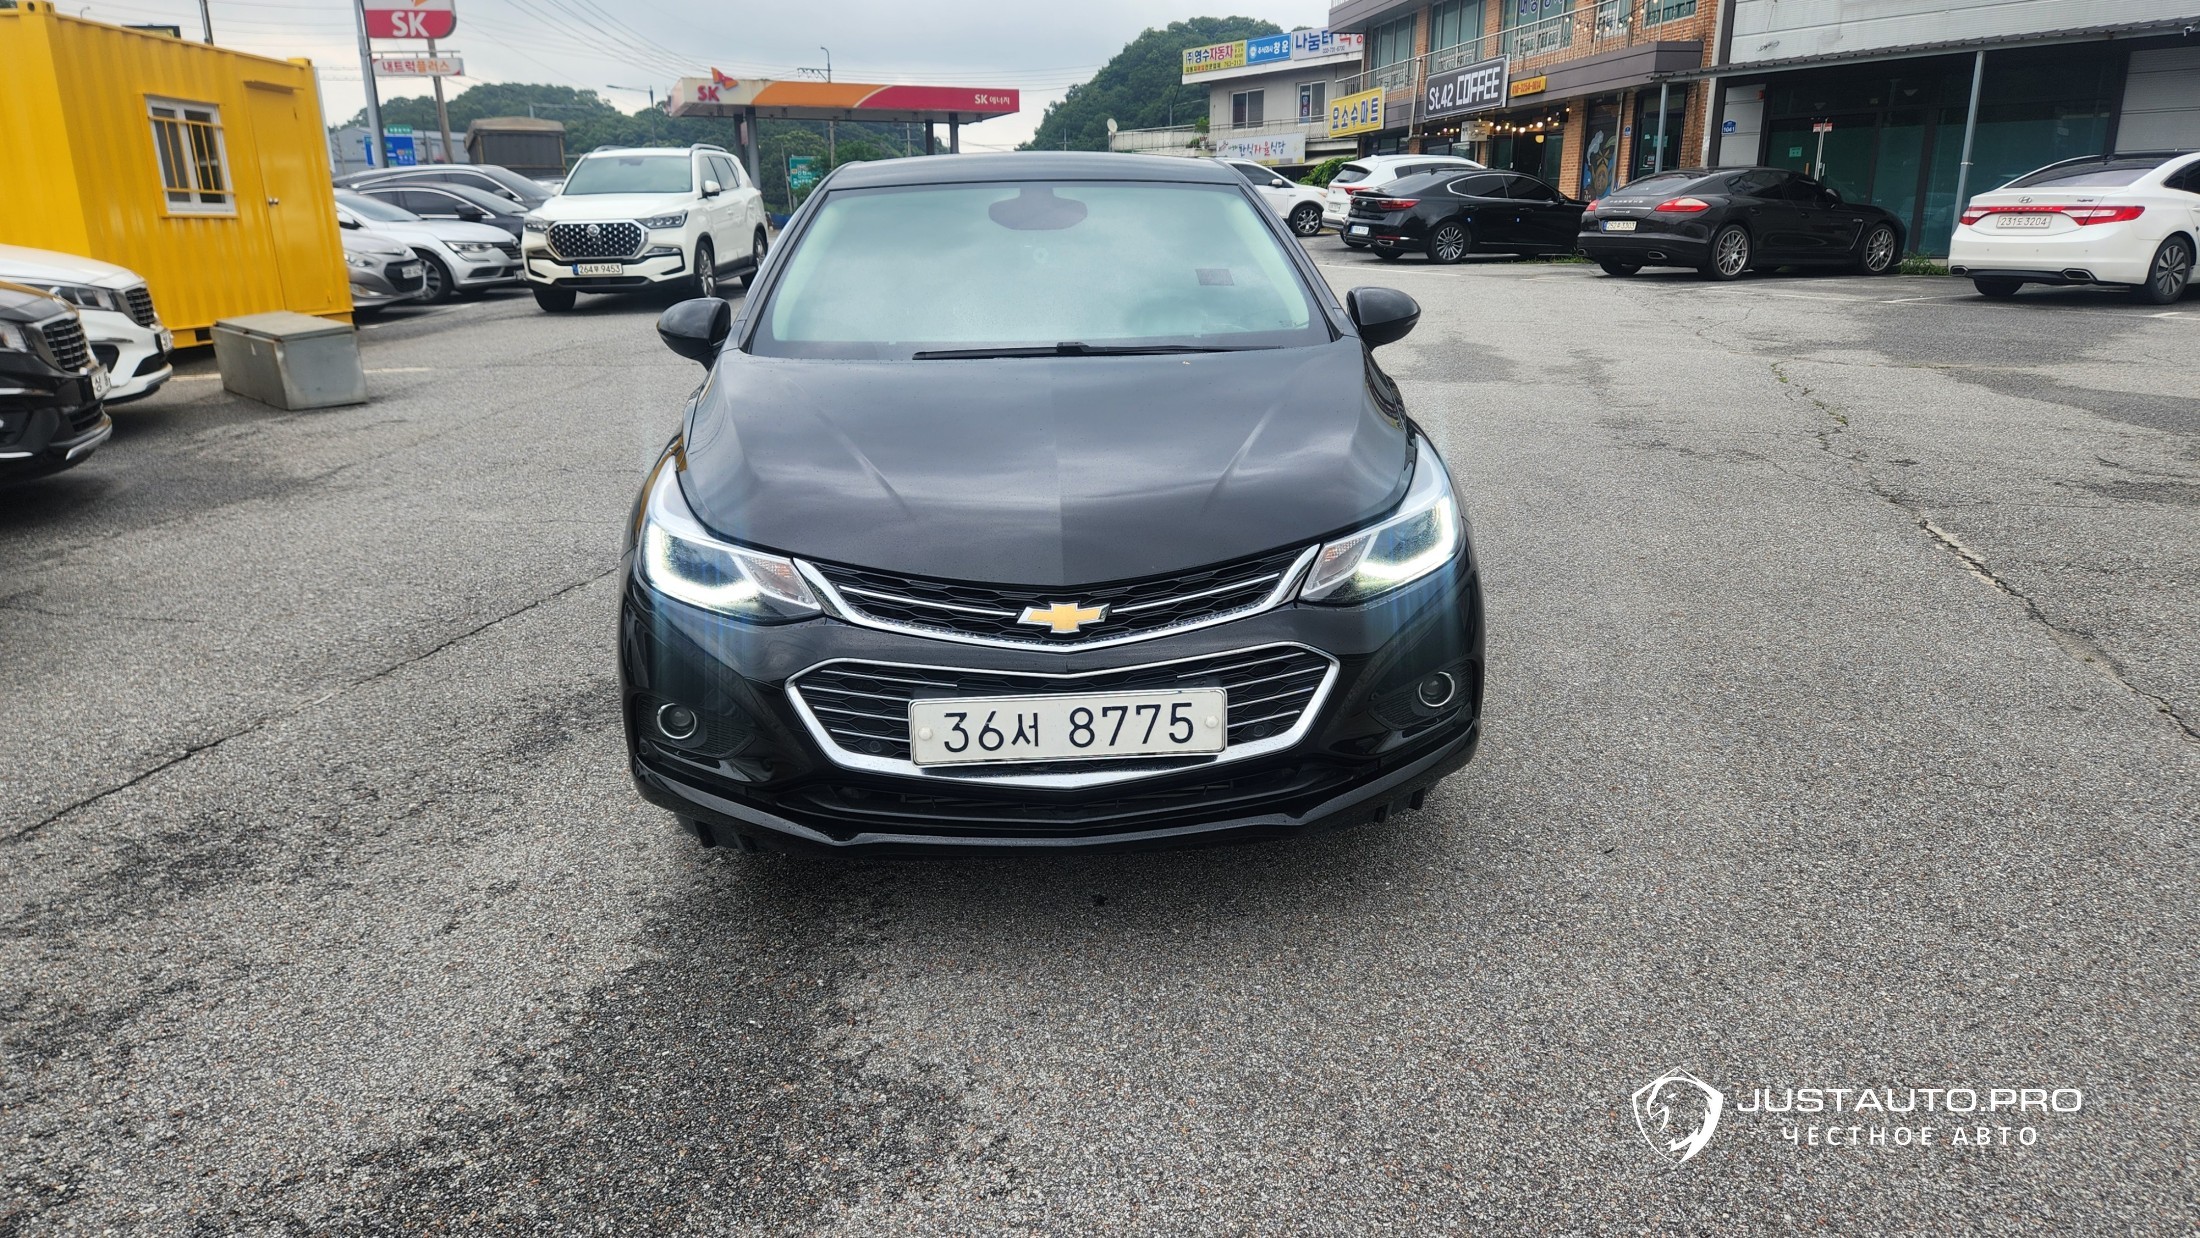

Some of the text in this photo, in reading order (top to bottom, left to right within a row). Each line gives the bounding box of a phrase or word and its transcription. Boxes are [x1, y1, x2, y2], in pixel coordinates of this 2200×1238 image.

[391, 11, 430, 37] SK
[382, 60, 451, 73] 내트럭플러스
[697, 85, 720, 102] SK
[1428, 66, 1501, 111] St.42 COFFEE
[974, 93, 1010, 105] SK 에너지
[1332, 97, 1379, 130] 요소수마트
[2023, 216, 2048, 226] 3204
[600, 264, 621, 273] 9453
[943, 702, 1195, 753] 36서 8775
